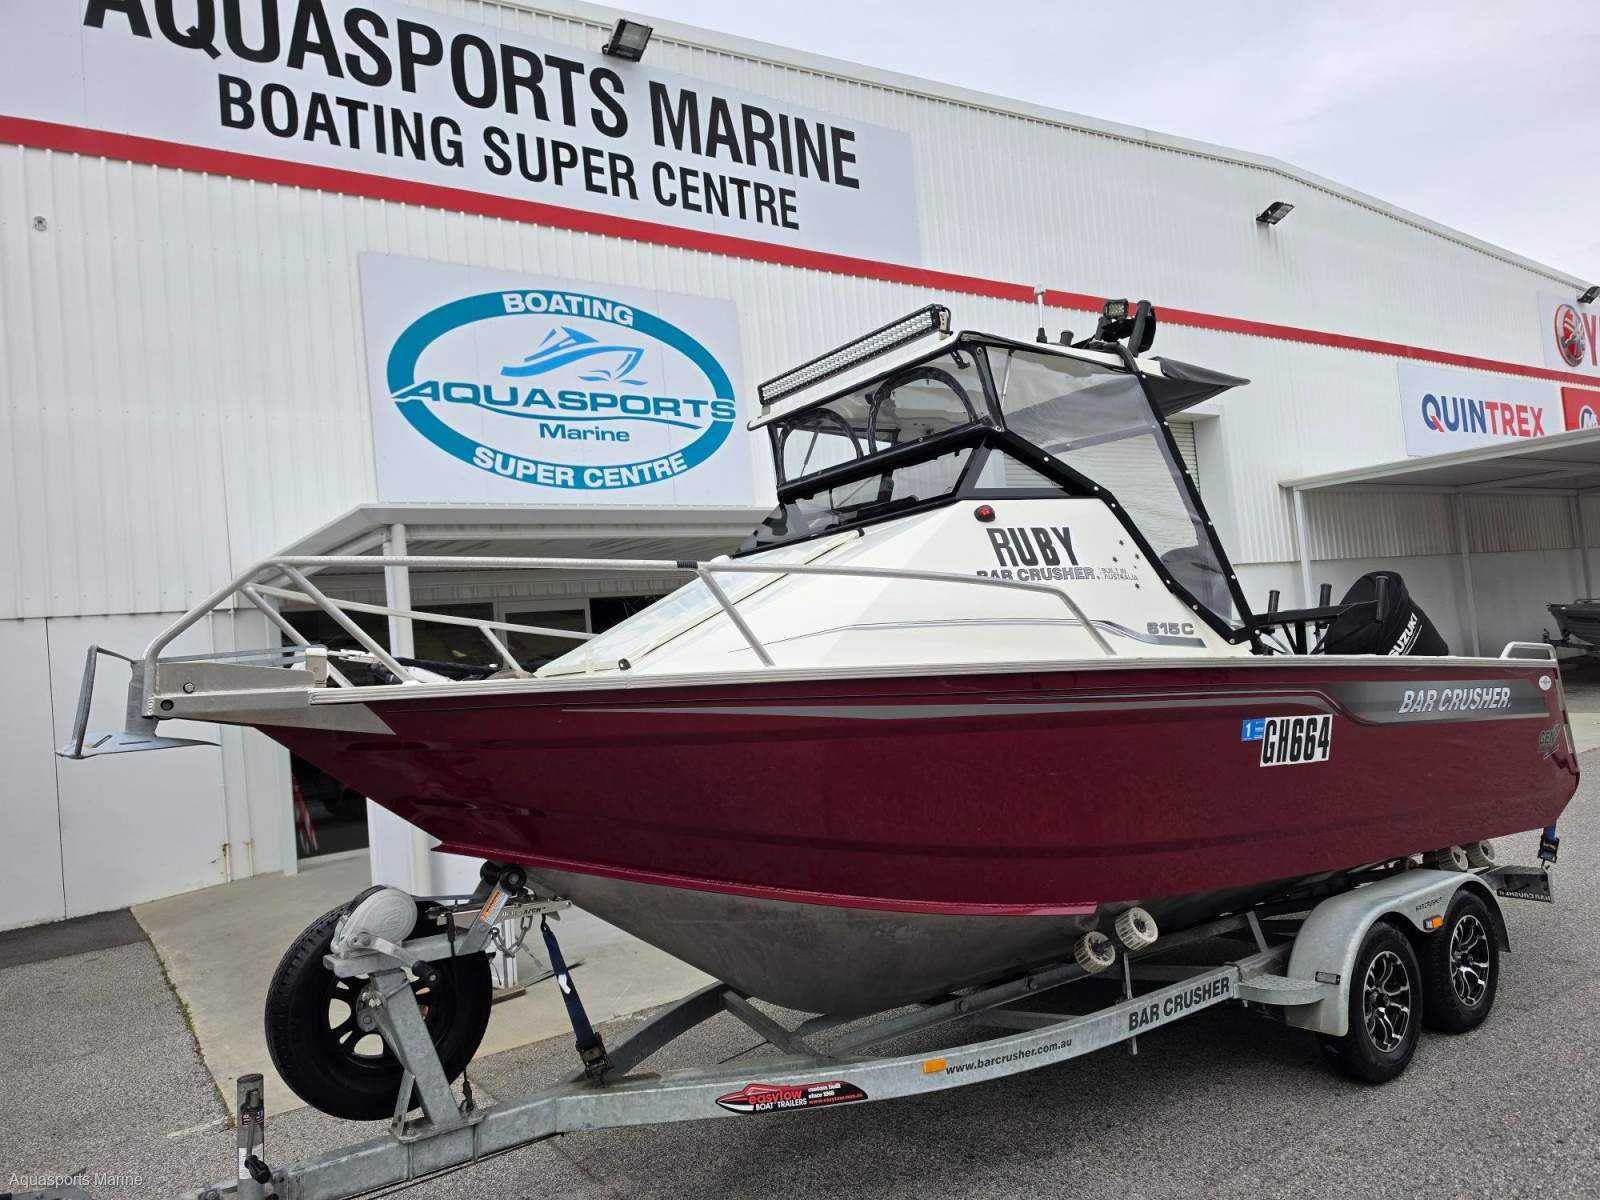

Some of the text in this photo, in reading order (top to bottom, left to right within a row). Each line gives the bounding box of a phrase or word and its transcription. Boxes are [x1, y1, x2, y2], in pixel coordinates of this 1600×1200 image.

[218, 73, 799, 231] BOATING SUPER CENTRE
[648, 80, 860, 190] MARINE
[502, 293, 634, 327] BOATING
[392, 380, 737, 422] AQUASPORTS
[1421, 393, 1545, 438] QUINTREX
[539, 423, 630, 443] Marine
[472, 446, 688, 489] SUPER CENTRE
[986, 527, 1079, 568] RUBY
[1017, 567, 1096, 582] CRUSHER
[1147, 622, 1194, 635] 615C
[1398, 690, 1437, 714] BAR
[1262, 716, 1330, 764] GH664
[1128, 976, 1230, 1031] BAR CRUSHER
[945, 1037, 1072, 1075] www.barcrusher.com.au
[755, 1097, 808, 1111] BOAT TRAILERS
